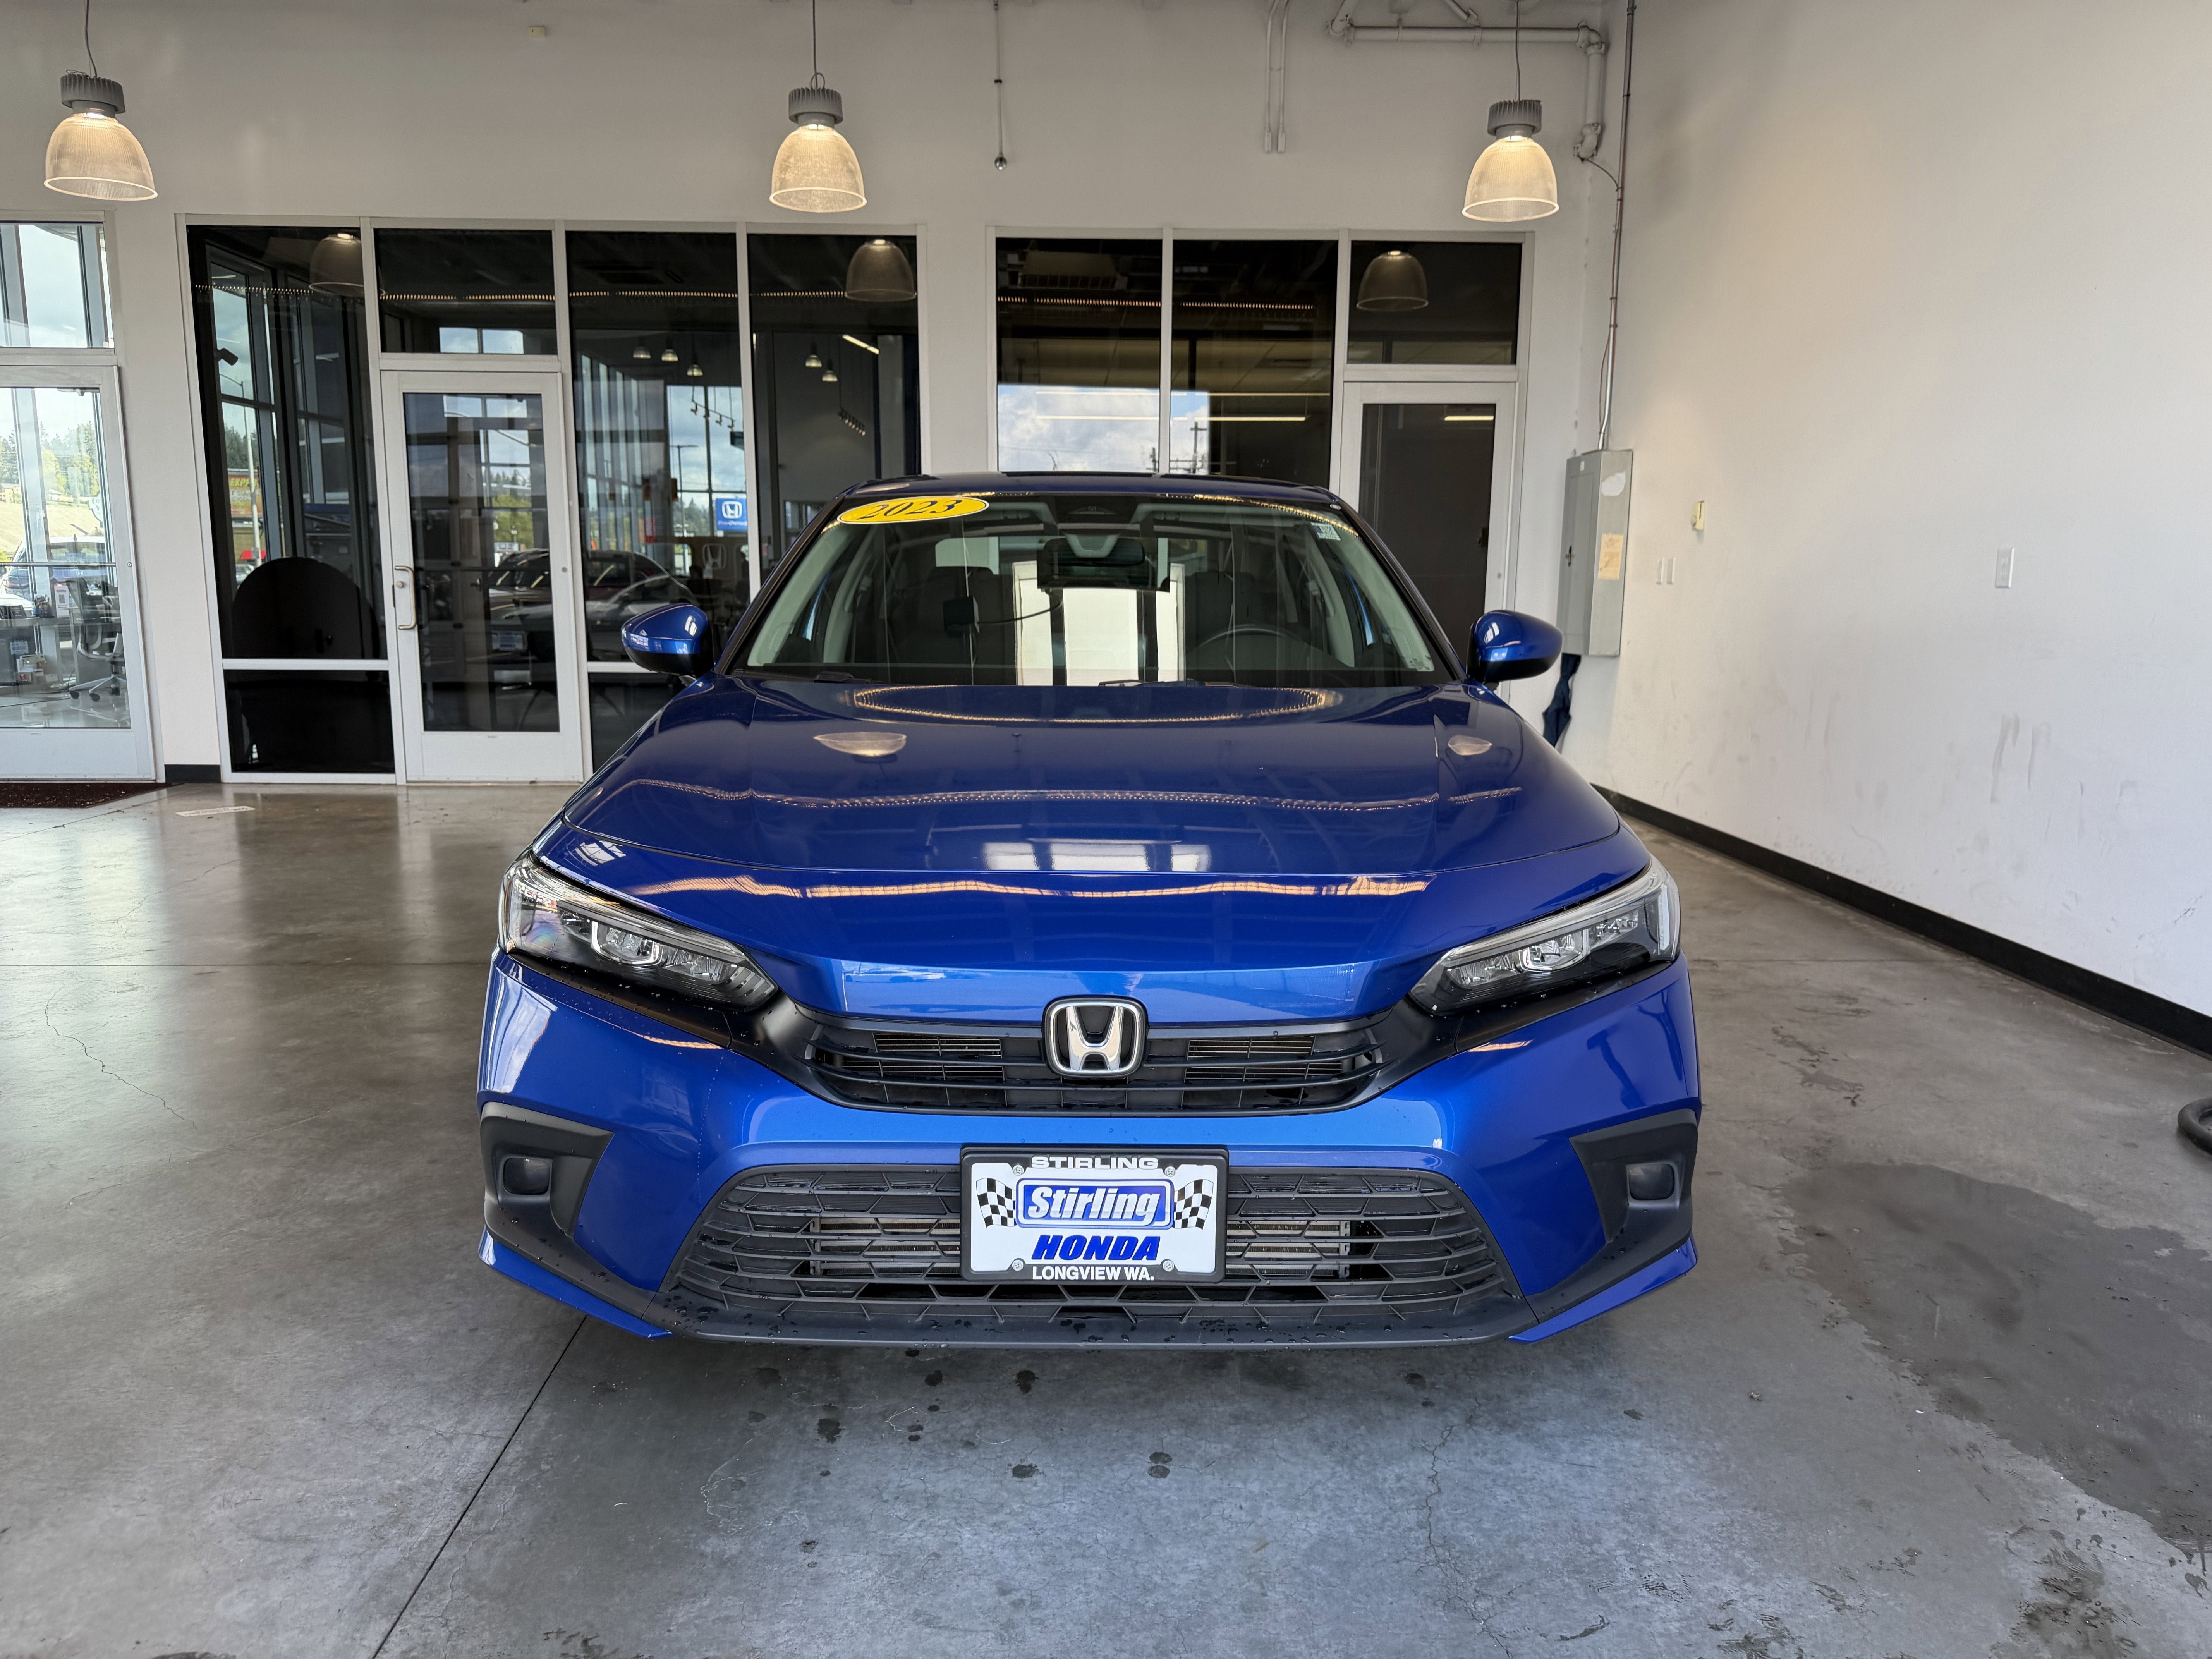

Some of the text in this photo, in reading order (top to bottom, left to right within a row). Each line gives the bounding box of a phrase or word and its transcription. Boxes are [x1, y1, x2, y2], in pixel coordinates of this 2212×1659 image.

[856, 499, 963, 520] 2023
[1031, 1156, 1159, 1170] STIRLING
[1027, 1186, 1161, 1226] Stirling
[1031, 1235, 1161, 1261] HONDA
[1032, 1266, 1121, 1281] LONGVIEW
